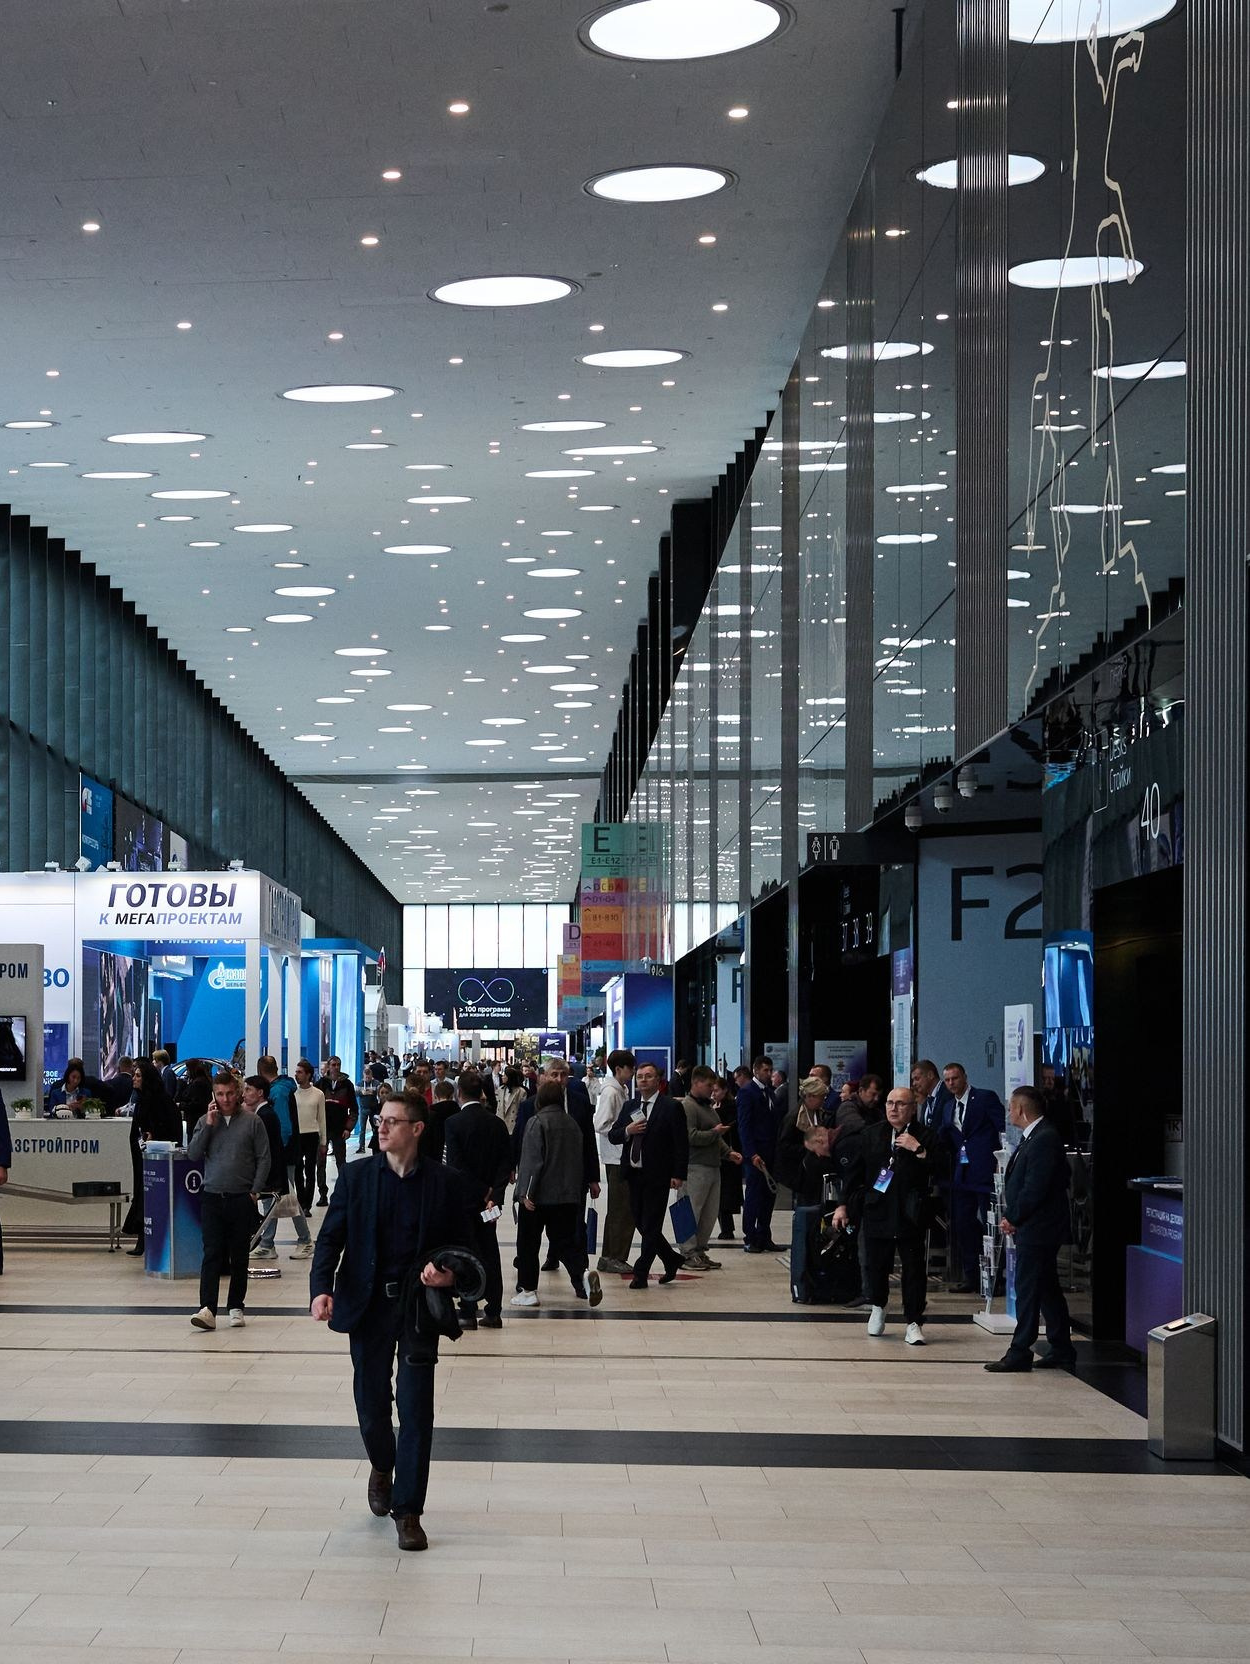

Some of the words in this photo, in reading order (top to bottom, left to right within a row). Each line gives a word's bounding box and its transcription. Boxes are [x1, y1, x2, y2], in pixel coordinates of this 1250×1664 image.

[1141, 783, 1160, 841] 40
[594, 827, 610, 853] E
[591, 857, 620, 865] E1-E12
[108, 883, 238, 908] ГОТОВЫ
[951, 865, 1043, 941] F2
[99, 912, 109, 925] К
[115, 912, 243, 925] МЕГАПРОЕКТАМ
[43, 968, 70, 988] ВО
[11, 1137, 100, 1153] ЗСТРОЙПРОМ
